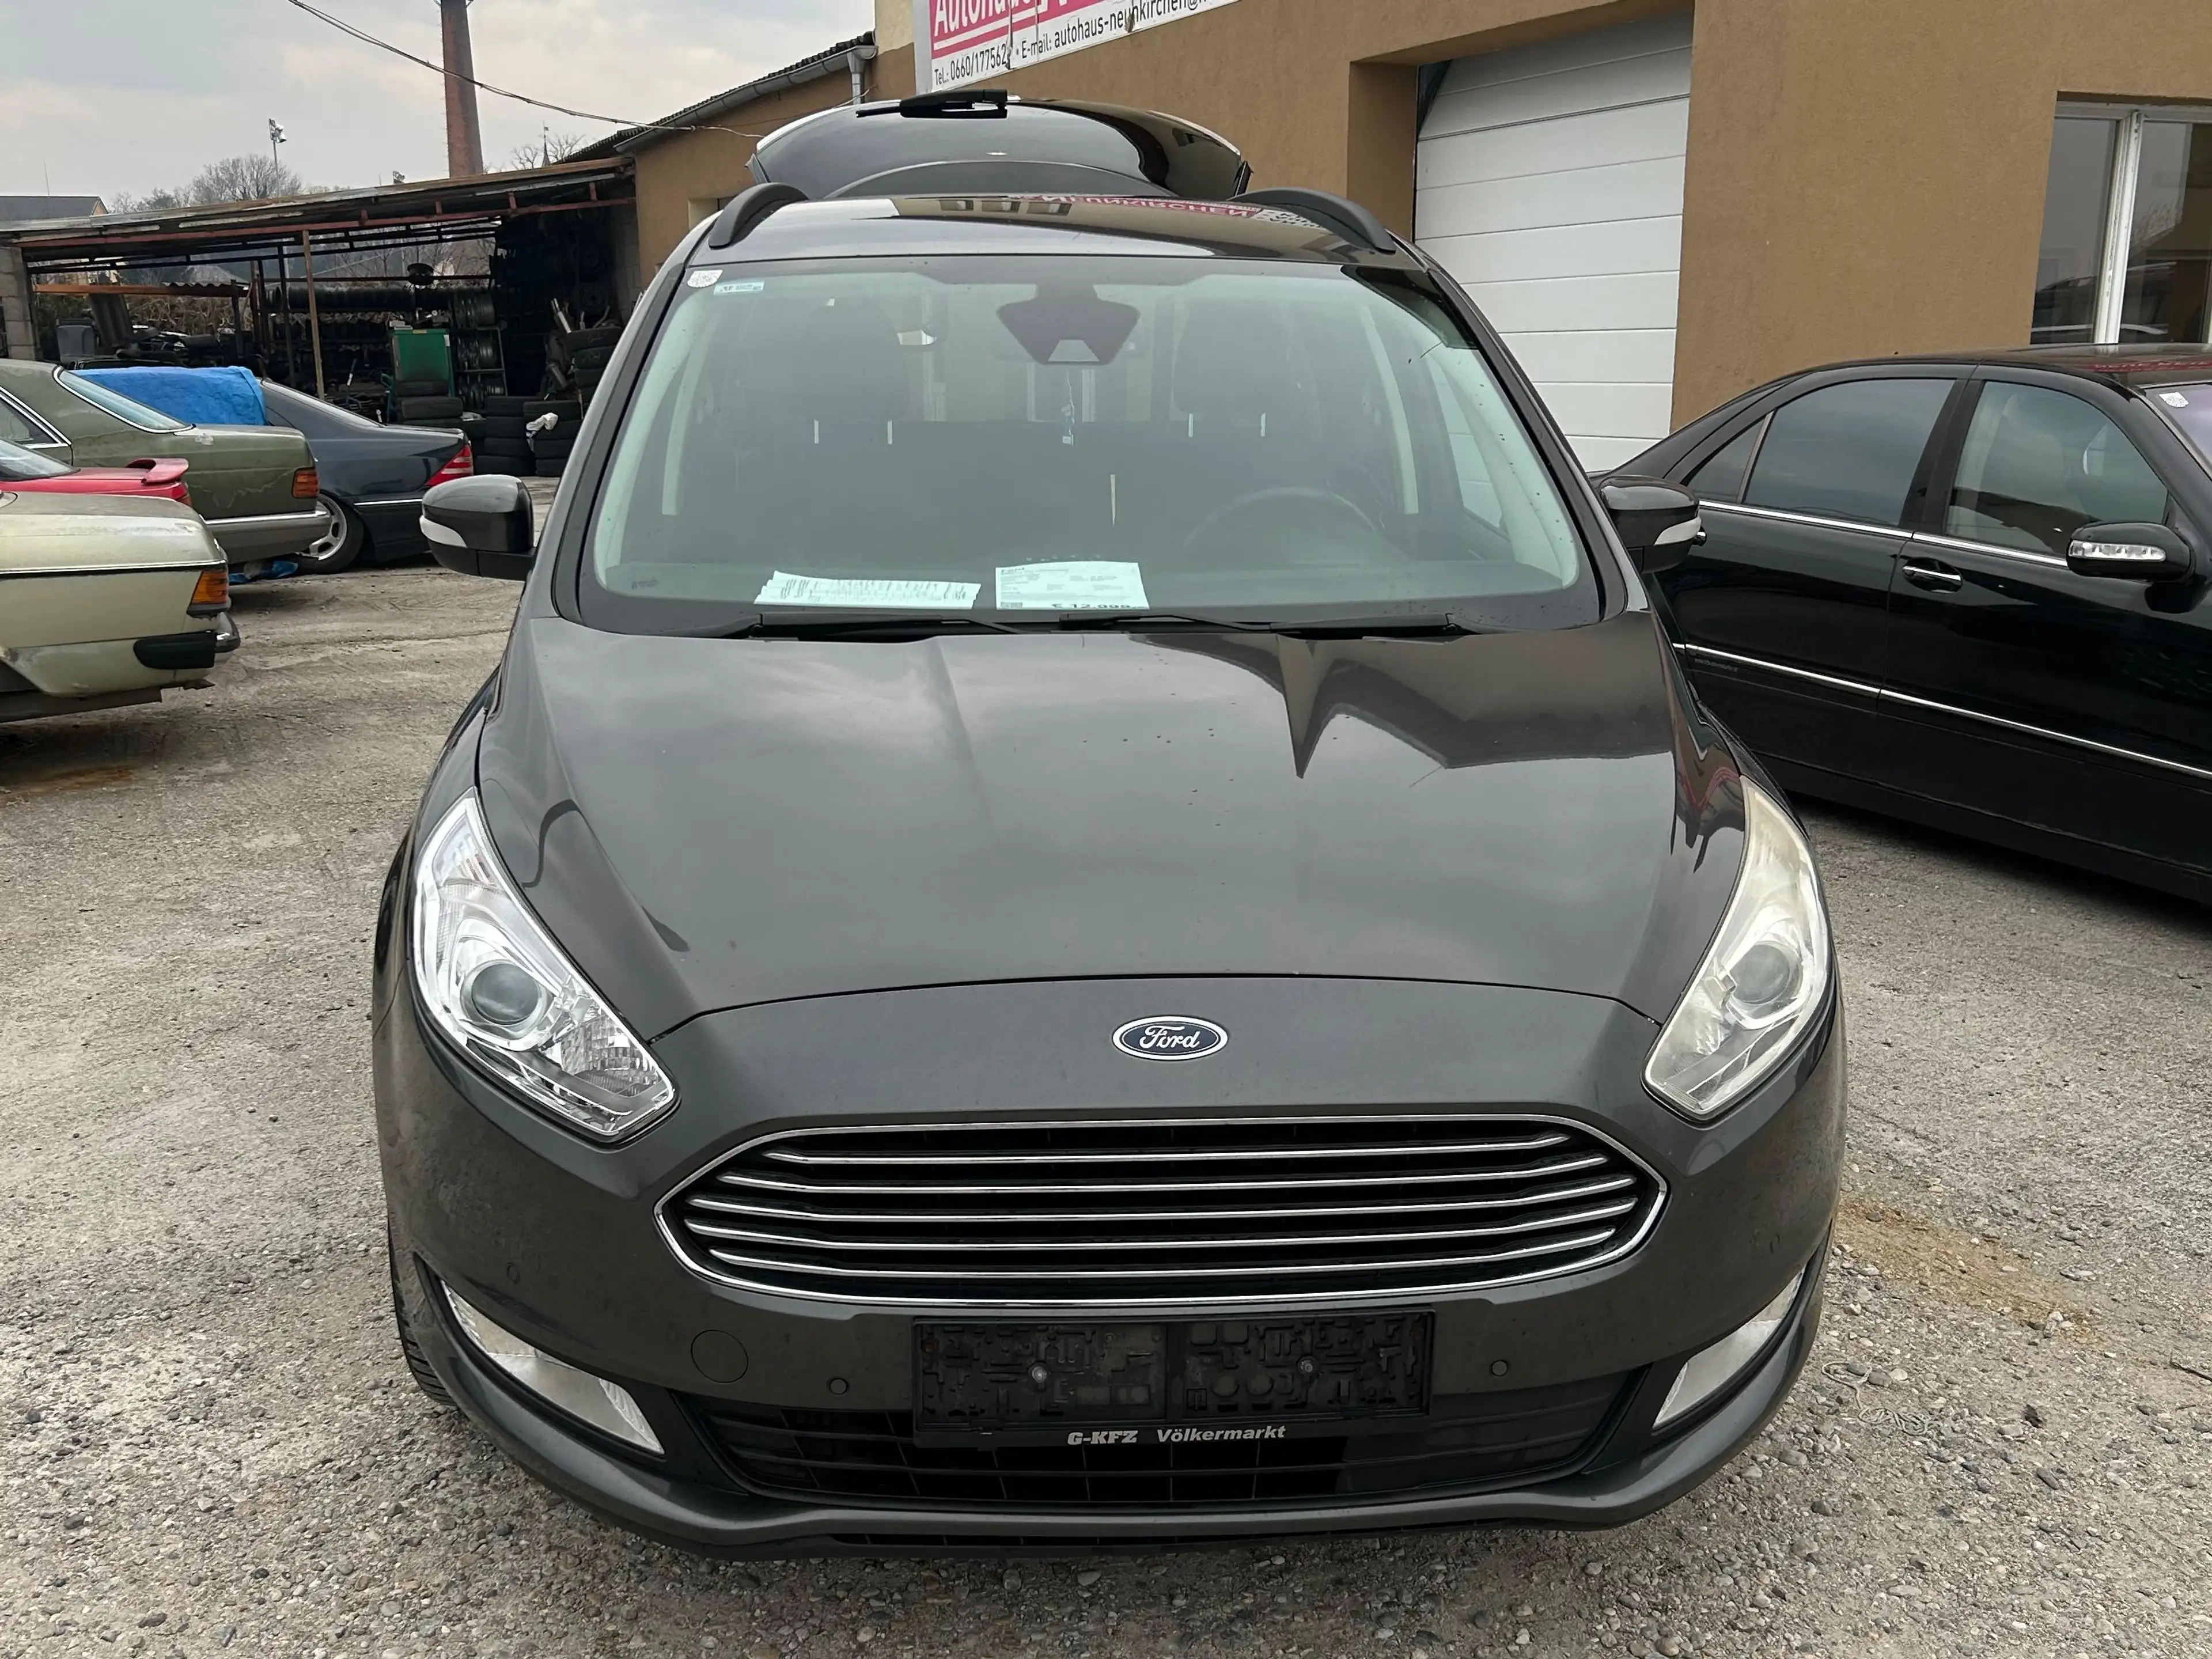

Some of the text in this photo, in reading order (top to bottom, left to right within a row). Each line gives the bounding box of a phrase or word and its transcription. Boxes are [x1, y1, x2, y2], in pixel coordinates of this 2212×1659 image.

[934, 69, 949, 85] Tel.:
[950, 43, 1011, 81] 0660/177562
[1022, 33, 1052, 59] E-mail:
[1139, 1025, 1200, 1048] Ford
[1067, 1425, 1286, 1445] G-KFZ Völkermarkt
